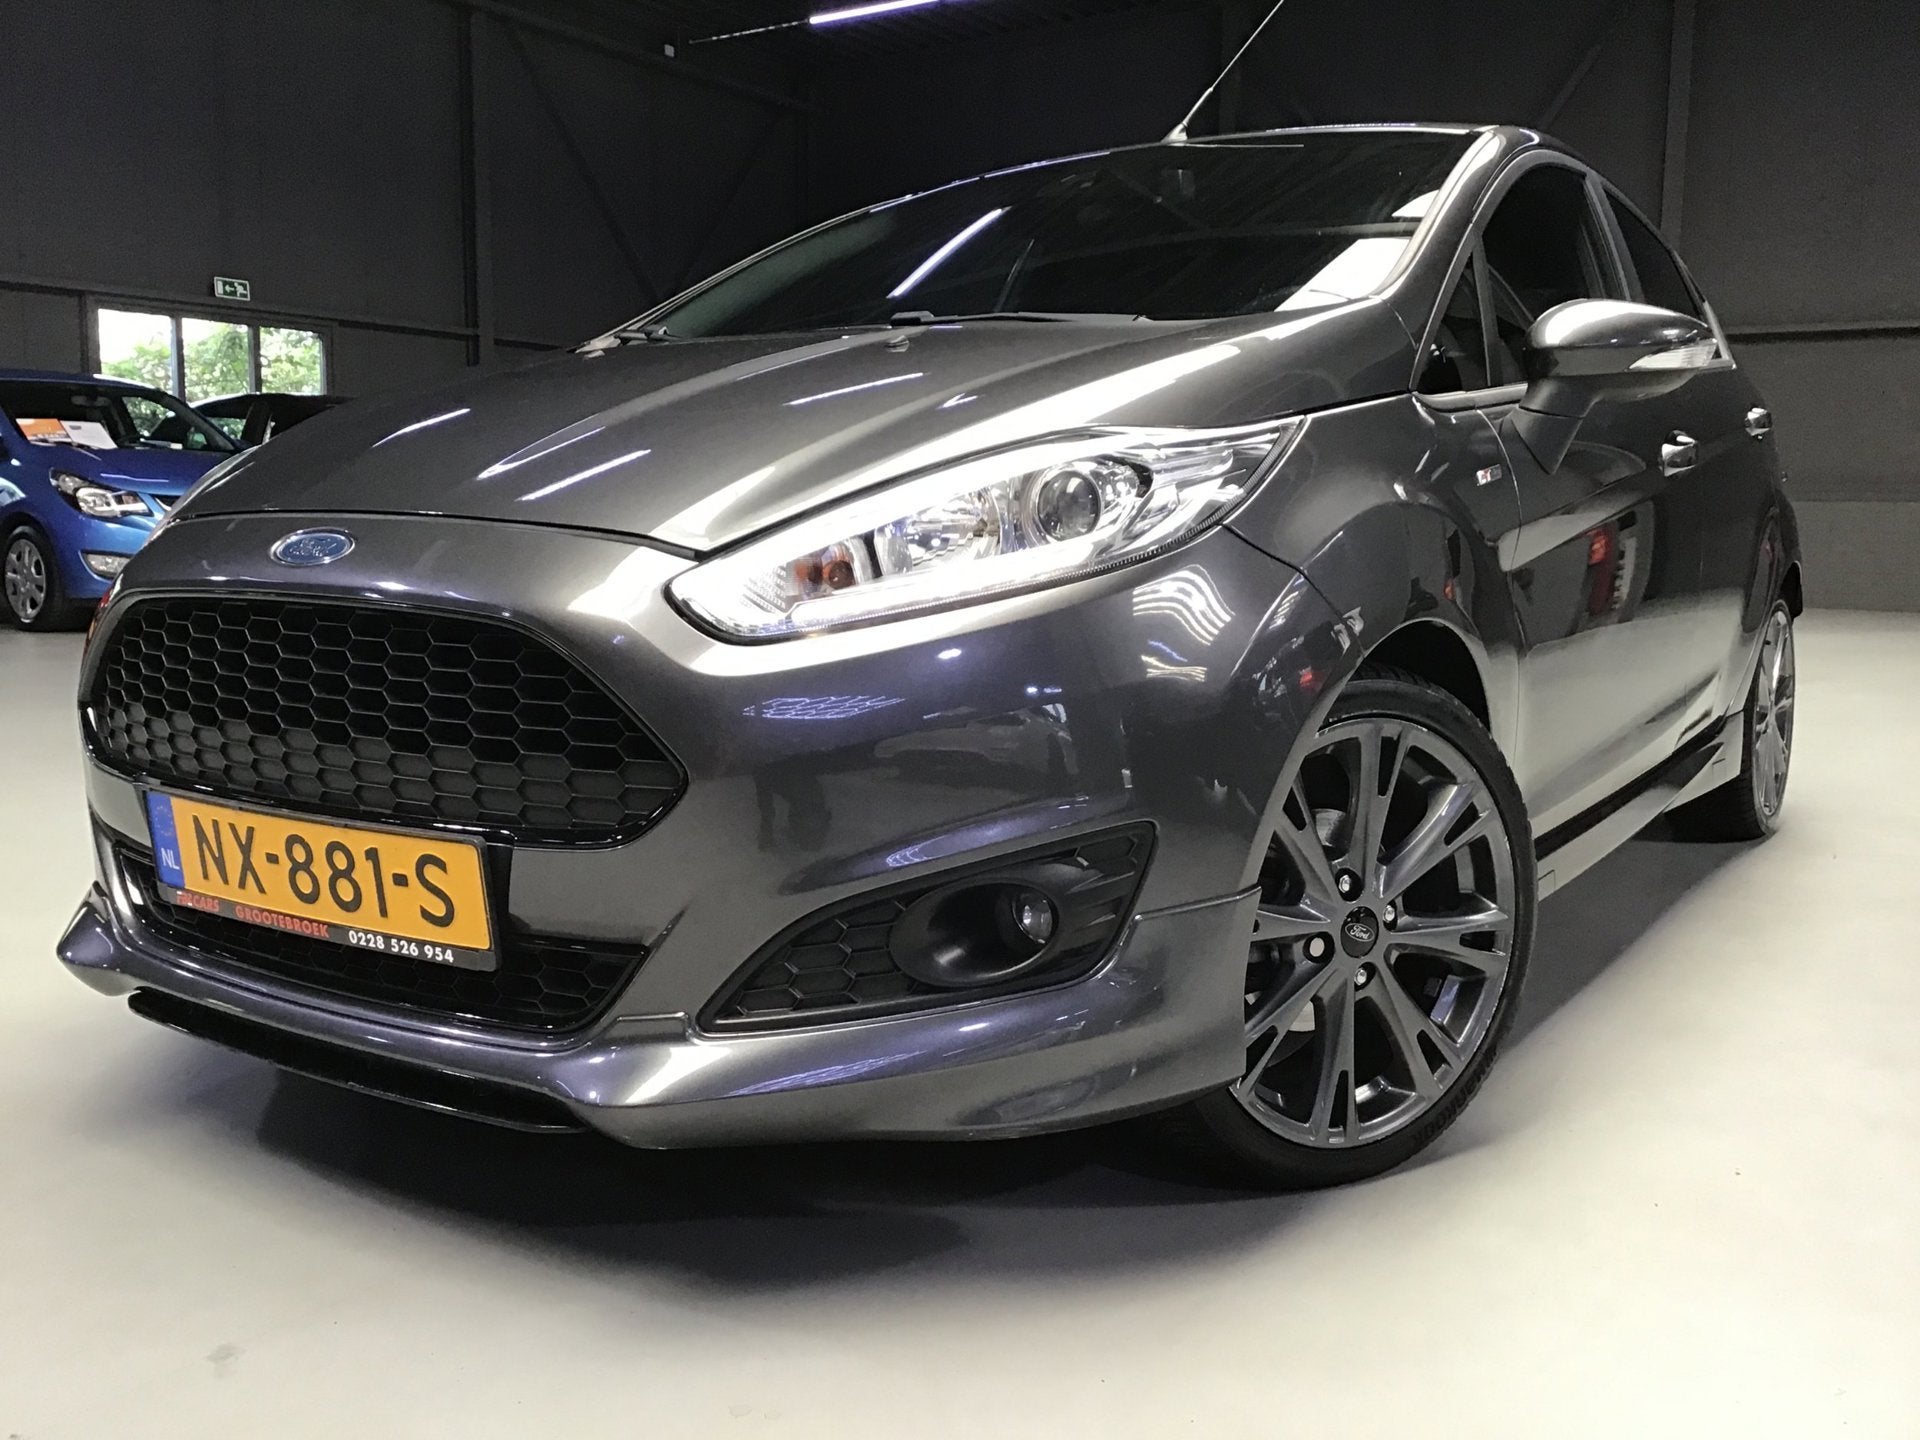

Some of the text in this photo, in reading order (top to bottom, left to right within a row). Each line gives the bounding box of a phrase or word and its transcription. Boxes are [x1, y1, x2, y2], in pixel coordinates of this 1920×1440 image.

[161, 847, 180, 869] NL
[192, 814, 455, 928] NX-881-S
[235, 905, 330, 938] GROOTEBROEK
[1349, 924, 1371, 939] Ford
[348, 930, 454, 963] 0228 526 954
